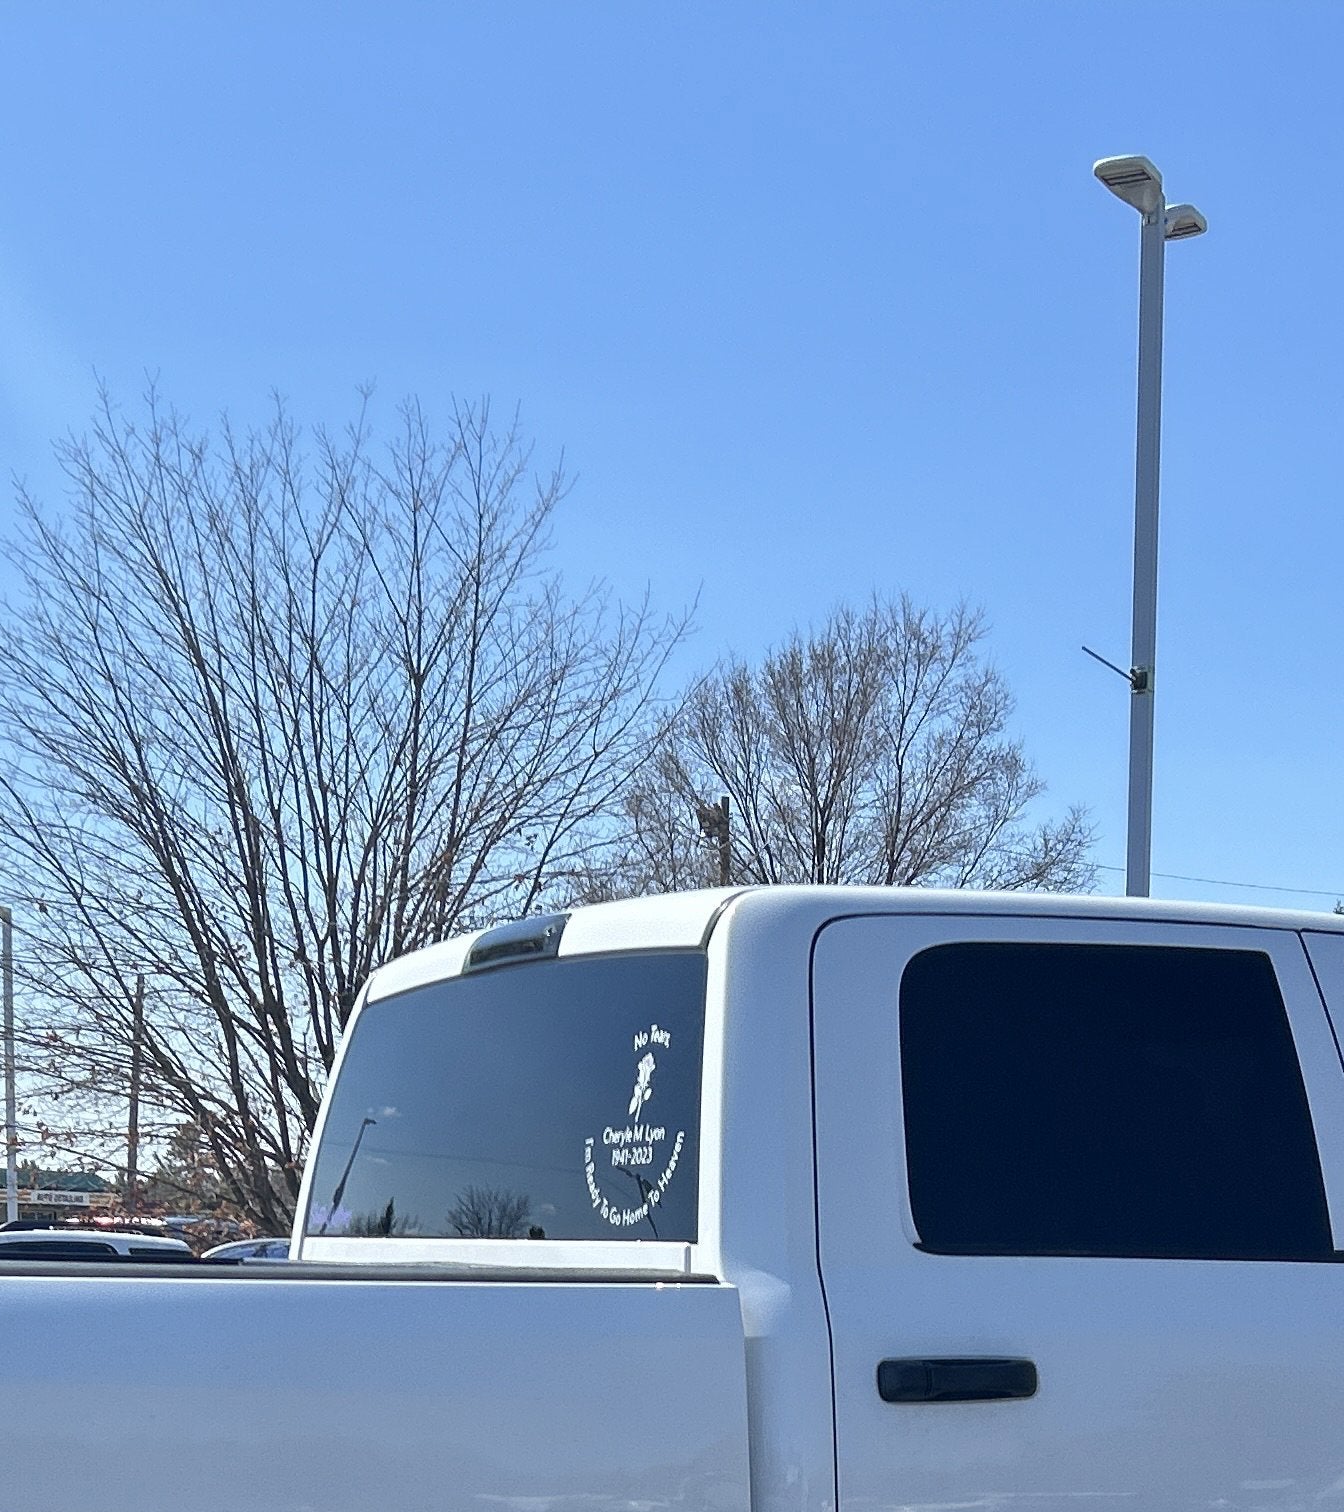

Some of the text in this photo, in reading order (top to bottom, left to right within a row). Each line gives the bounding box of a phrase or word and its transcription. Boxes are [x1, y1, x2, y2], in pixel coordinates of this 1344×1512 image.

[634, 1030, 649, 1051] No
[633, 1124, 644, 1142] M
[645, 1123, 666, 1146] Lyon
[611, 1146, 653, 1167] 1941-2023
[585, 1161, 602, 1208] Ready
[600, 1197, 609, 1219] To
[609, 1206, 621, 1226] Go
[622, 1203, 649, 1227] Home
[647, 1189, 660, 1208] To
[657, 1130, 685, 1193] Heaven
